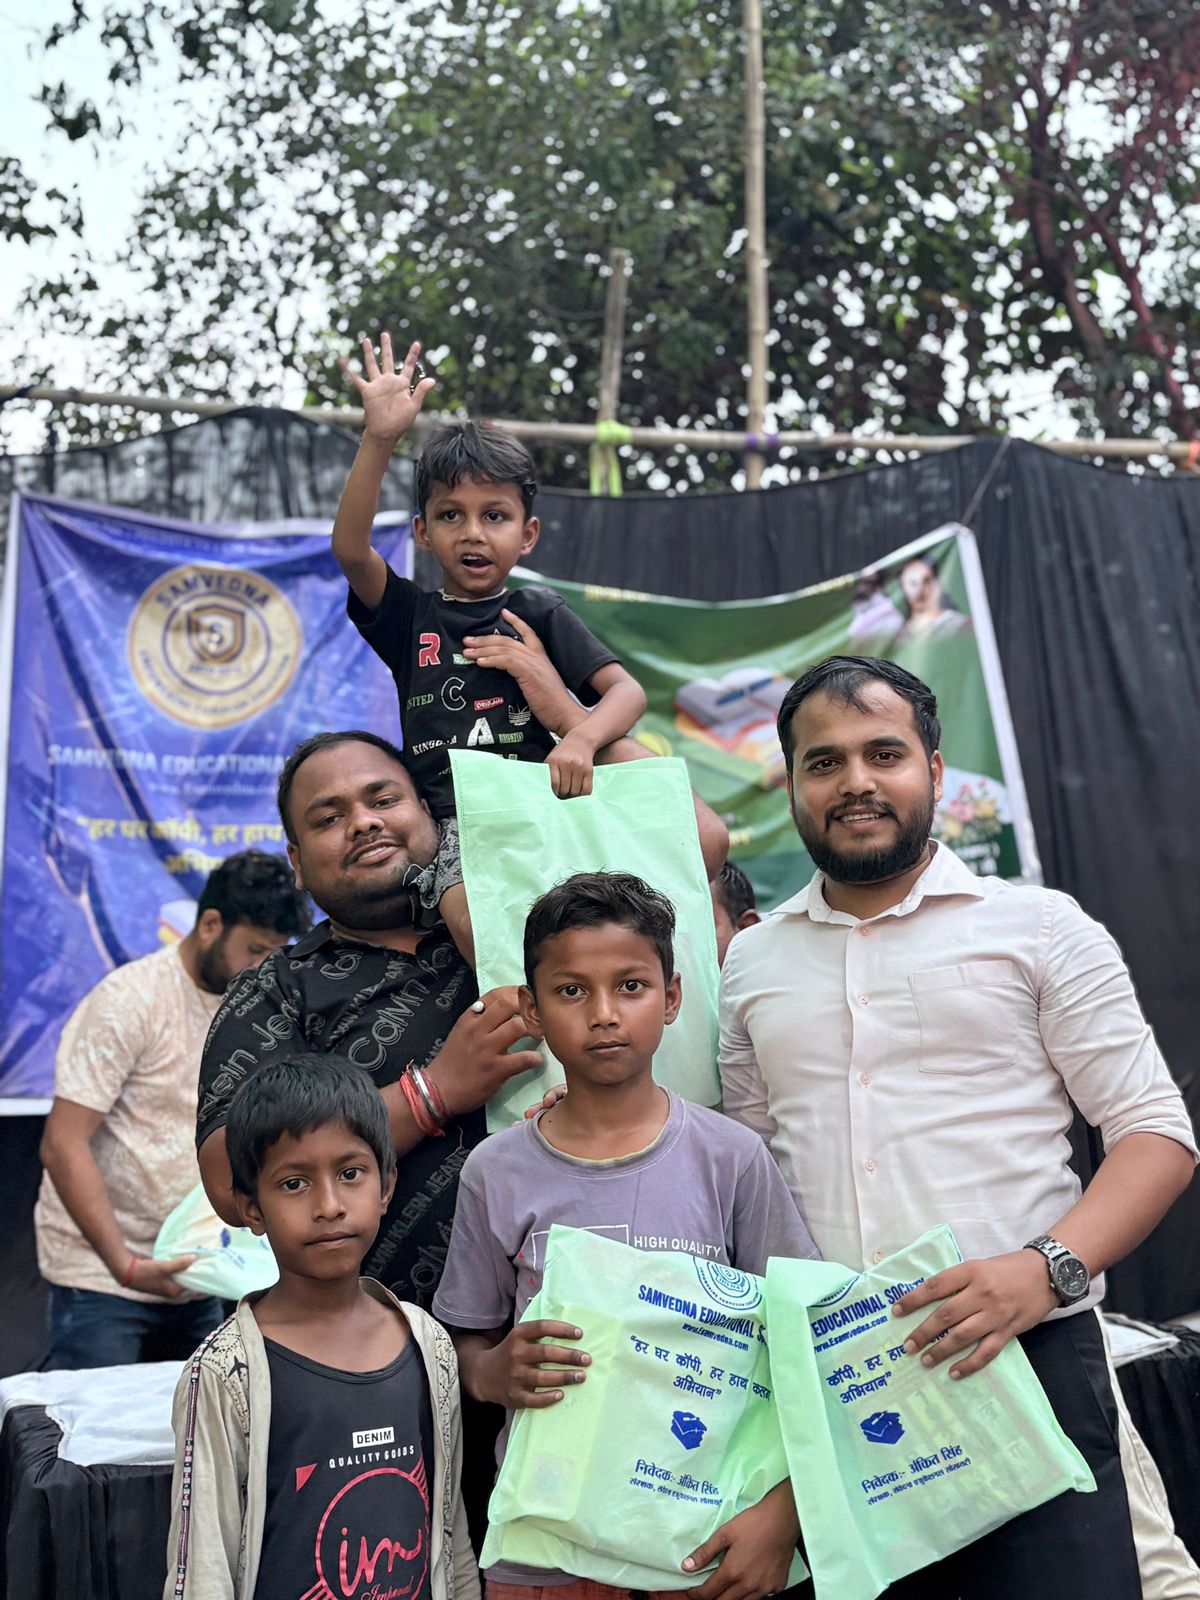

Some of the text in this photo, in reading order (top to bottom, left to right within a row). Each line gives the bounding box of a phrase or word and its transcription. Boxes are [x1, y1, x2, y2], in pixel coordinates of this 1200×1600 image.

[155, 573, 271, 609] SAMVEDNA
[418, 632, 442, 668] R
[440, 676, 467, 711] C
[466, 716, 496, 747] A
[634, 1236, 721, 1258] HIGH QUALITY
[638, 1284, 697, 1320] SAMVEDNA
[810, 1293, 888, 1338] EDUCATIONAL
[654, 1346, 671, 1362] घर
[675, 1352, 704, 1376] कॉपी,
[709, 1365, 725, 1381] हर
[728, 1372, 749, 1390] हाथ
[825, 1364, 862, 1387] कॉपी,
[863, 1354, 884, 1371] हर
[356, 1429, 392, 1445] DENIM
[328, 1444, 415, 1469] QUALITY GOODS
[908, 1453, 941, 1474] अंकित
[940, 1445, 963, 1461] सिंह
[676, 1473, 700, 1492] अंकित
